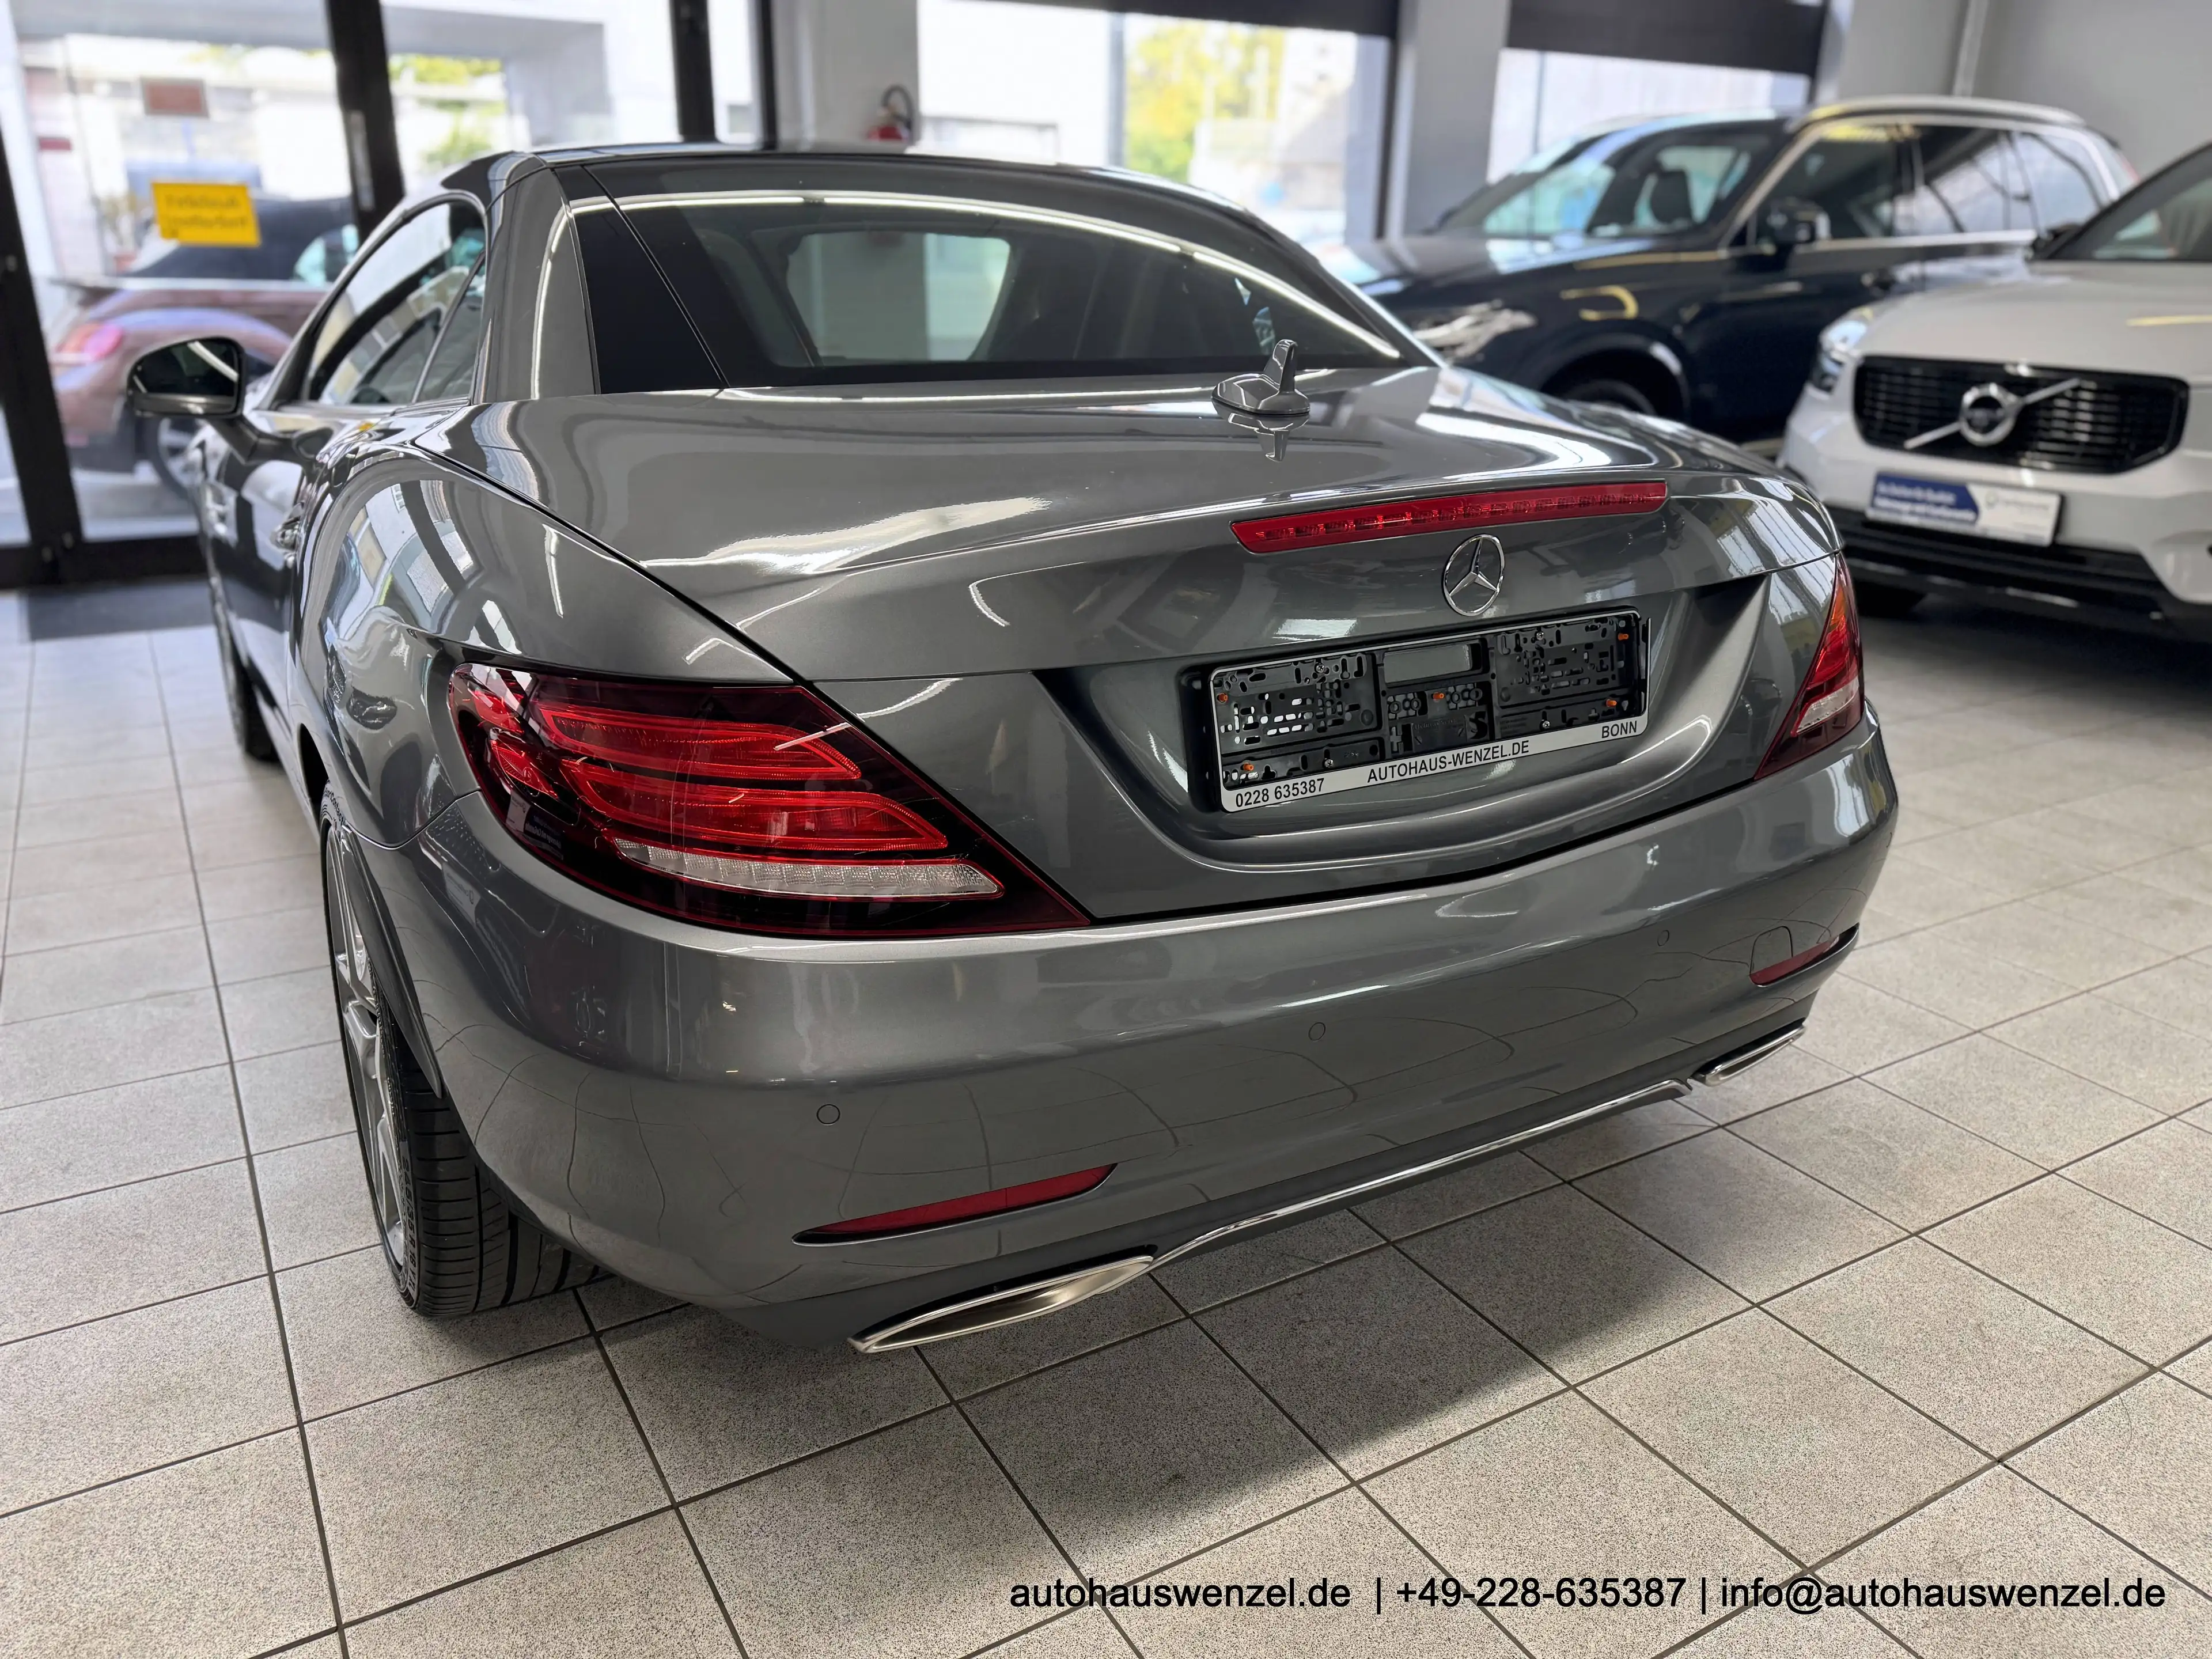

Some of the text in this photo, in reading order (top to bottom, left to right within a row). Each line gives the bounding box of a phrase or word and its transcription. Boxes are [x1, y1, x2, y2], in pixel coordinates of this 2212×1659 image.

[1236, 720, 1637, 808] 0228 635387 AUTOHAUS-WENZEL.DE BONN
[402, 1156, 415, 1234] 245/35
